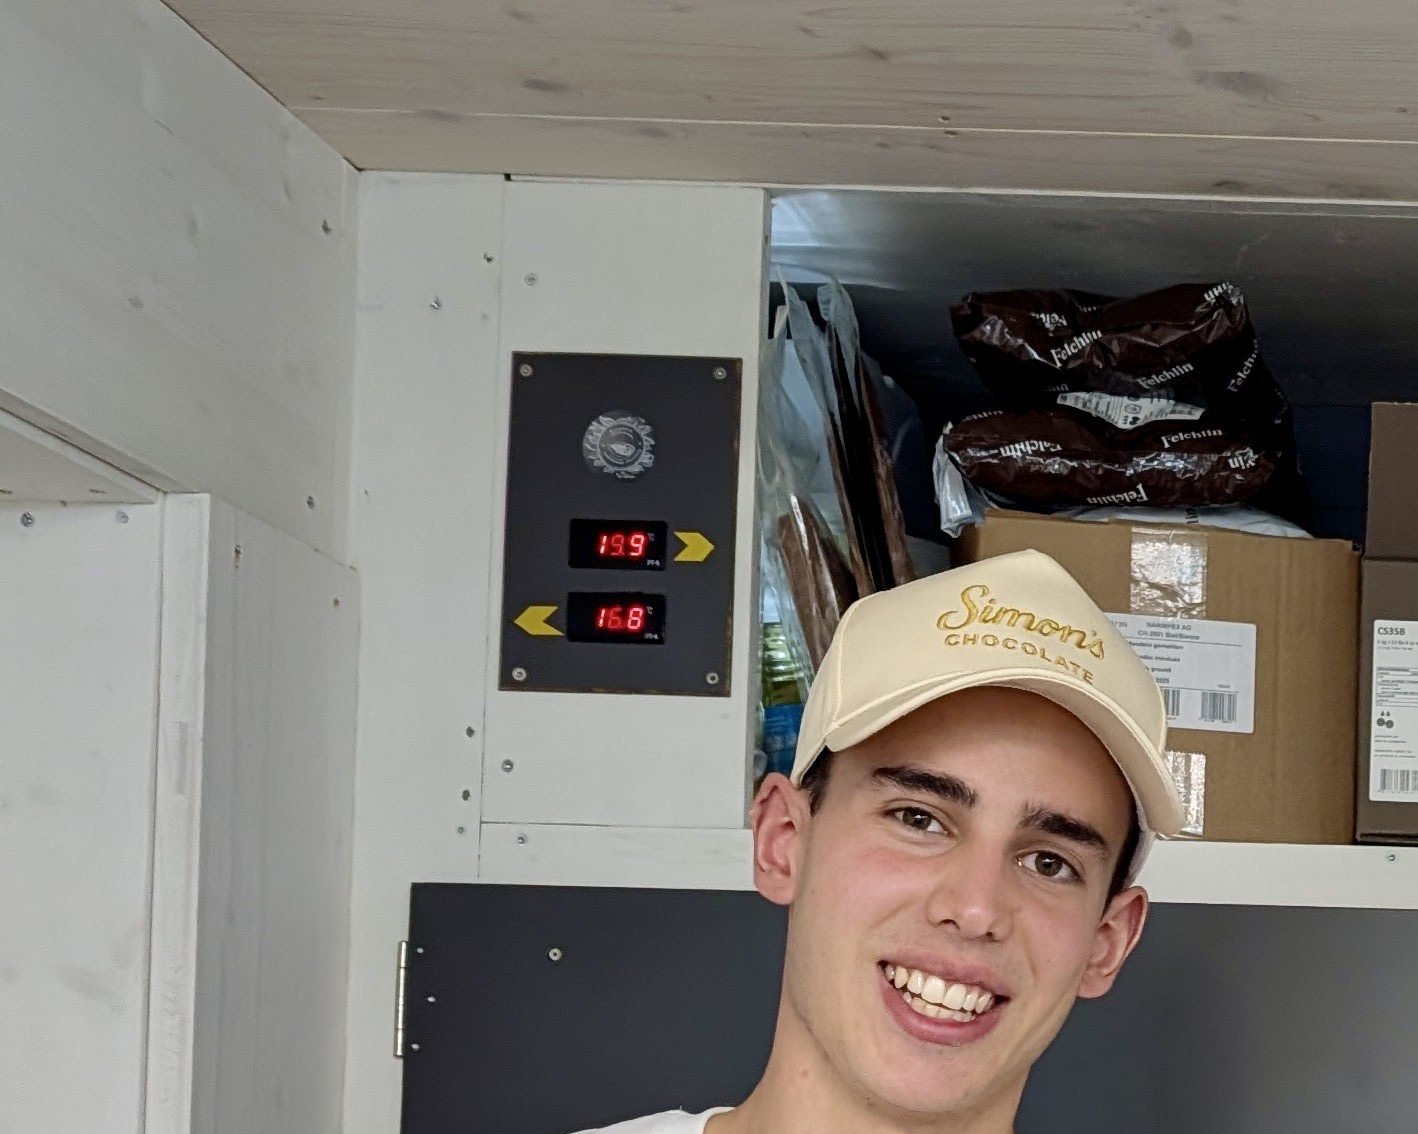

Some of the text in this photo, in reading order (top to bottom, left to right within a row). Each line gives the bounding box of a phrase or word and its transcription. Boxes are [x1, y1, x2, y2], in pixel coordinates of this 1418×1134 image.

[1137, 362, 1194, 389] Felchlin
[1086, 483, 1149, 505] Felchlin
[936, 584, 1105, 660] Simon's
[944, 633, 1095, 685] CHOCOLATE
